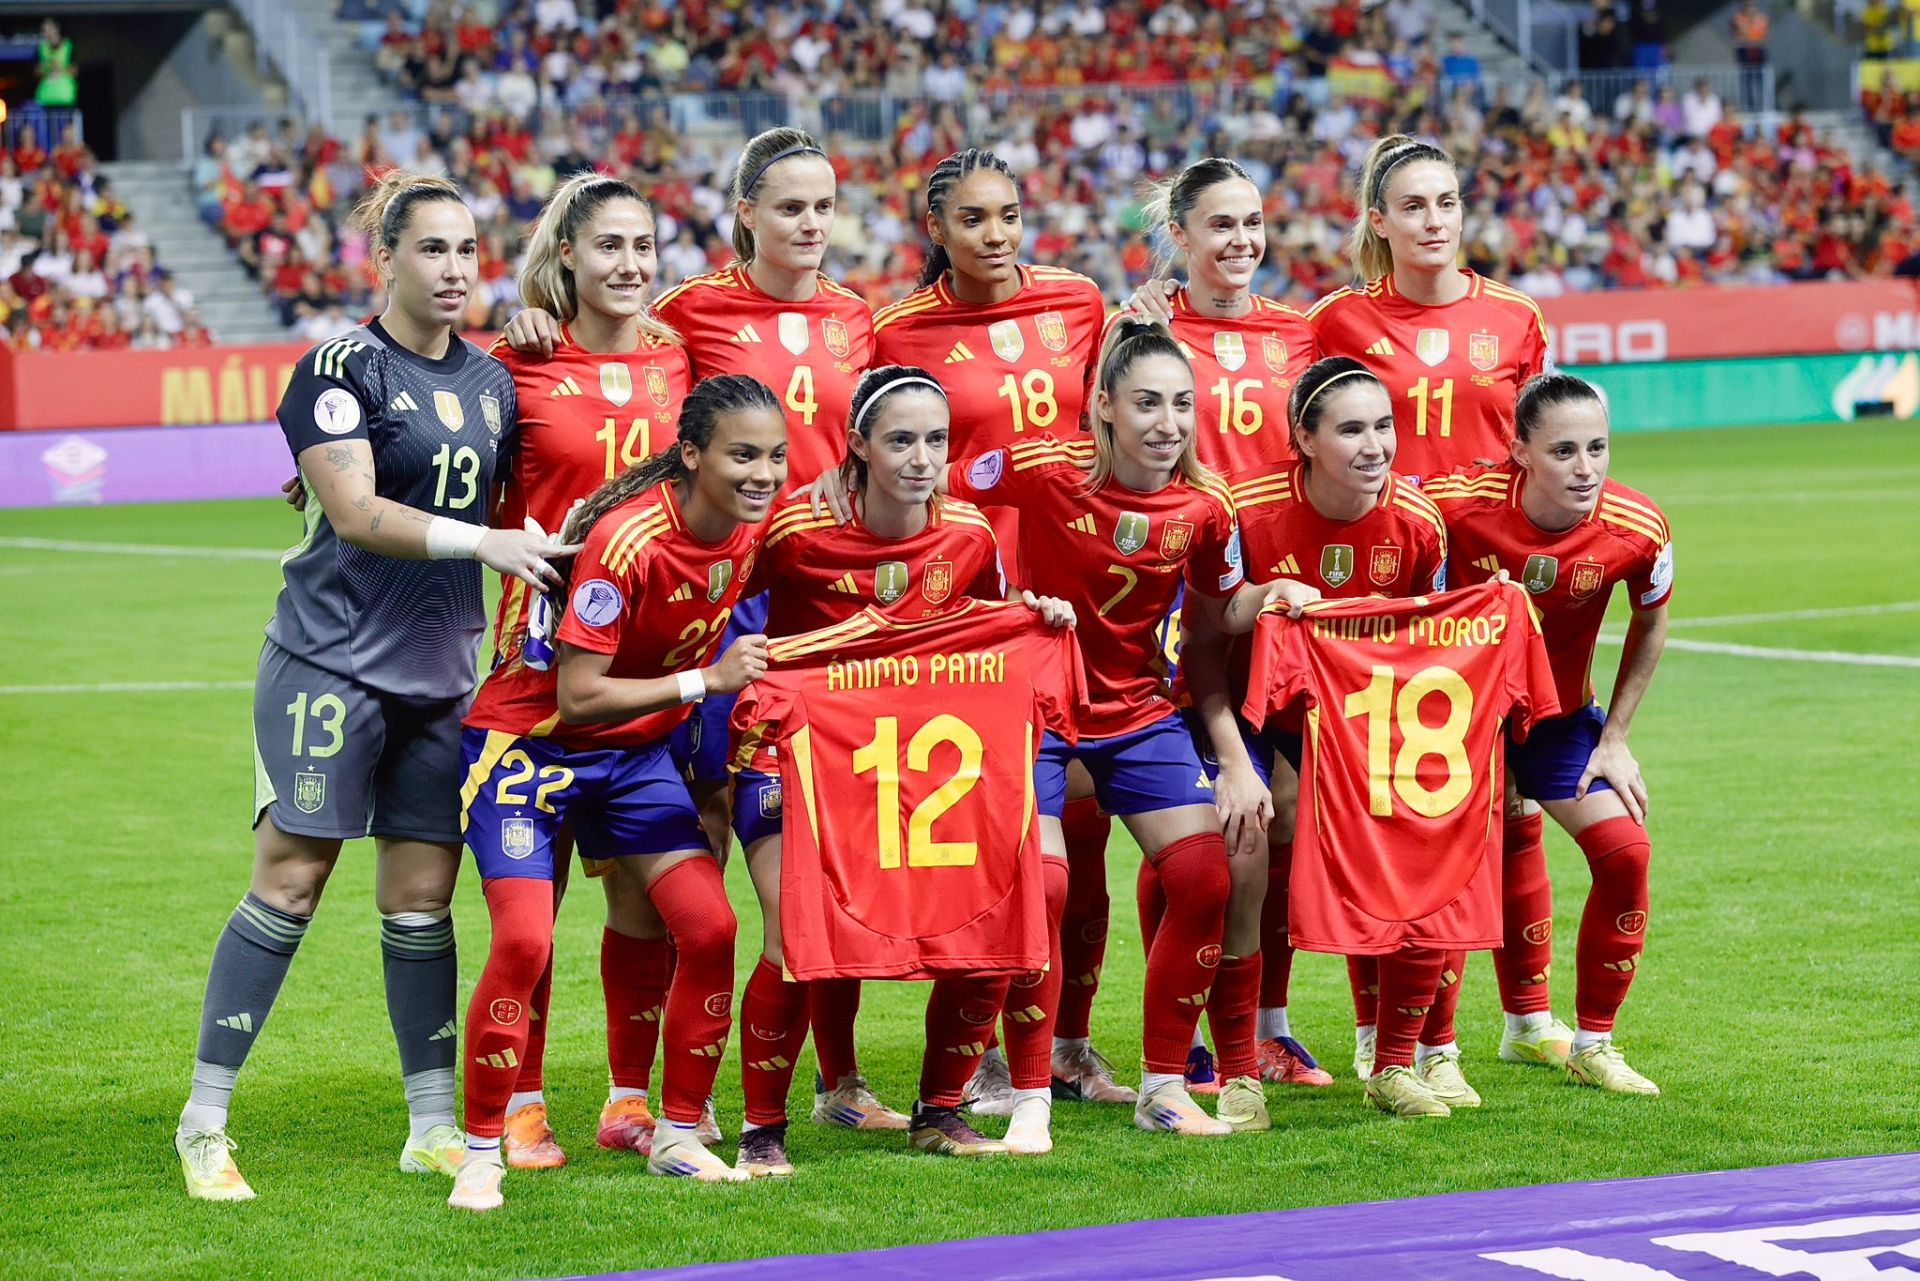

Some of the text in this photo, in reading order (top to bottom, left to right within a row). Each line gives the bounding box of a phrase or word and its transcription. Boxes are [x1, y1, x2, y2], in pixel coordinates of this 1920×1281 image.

[785, 365, 818, 425] 4
[998, 368, 1058, 432] 18
[1211, 377, 1264, 435] 16
[1407, 377, 1454, 437] 11
[432, 443, 480, 509] 13
[596, 418, 651, 480] 14
[1098, 564, 1138, 616] 7
[662, 607, 731, 666] 22
[827, 651, 1005, 691] ÁNIMO PATRI
[286, 692, 347, 758] 13
[1345, 665, 1474, 818] 18
[496, 749, 575, 814] 22
[853, 714, 983, 869] 12
